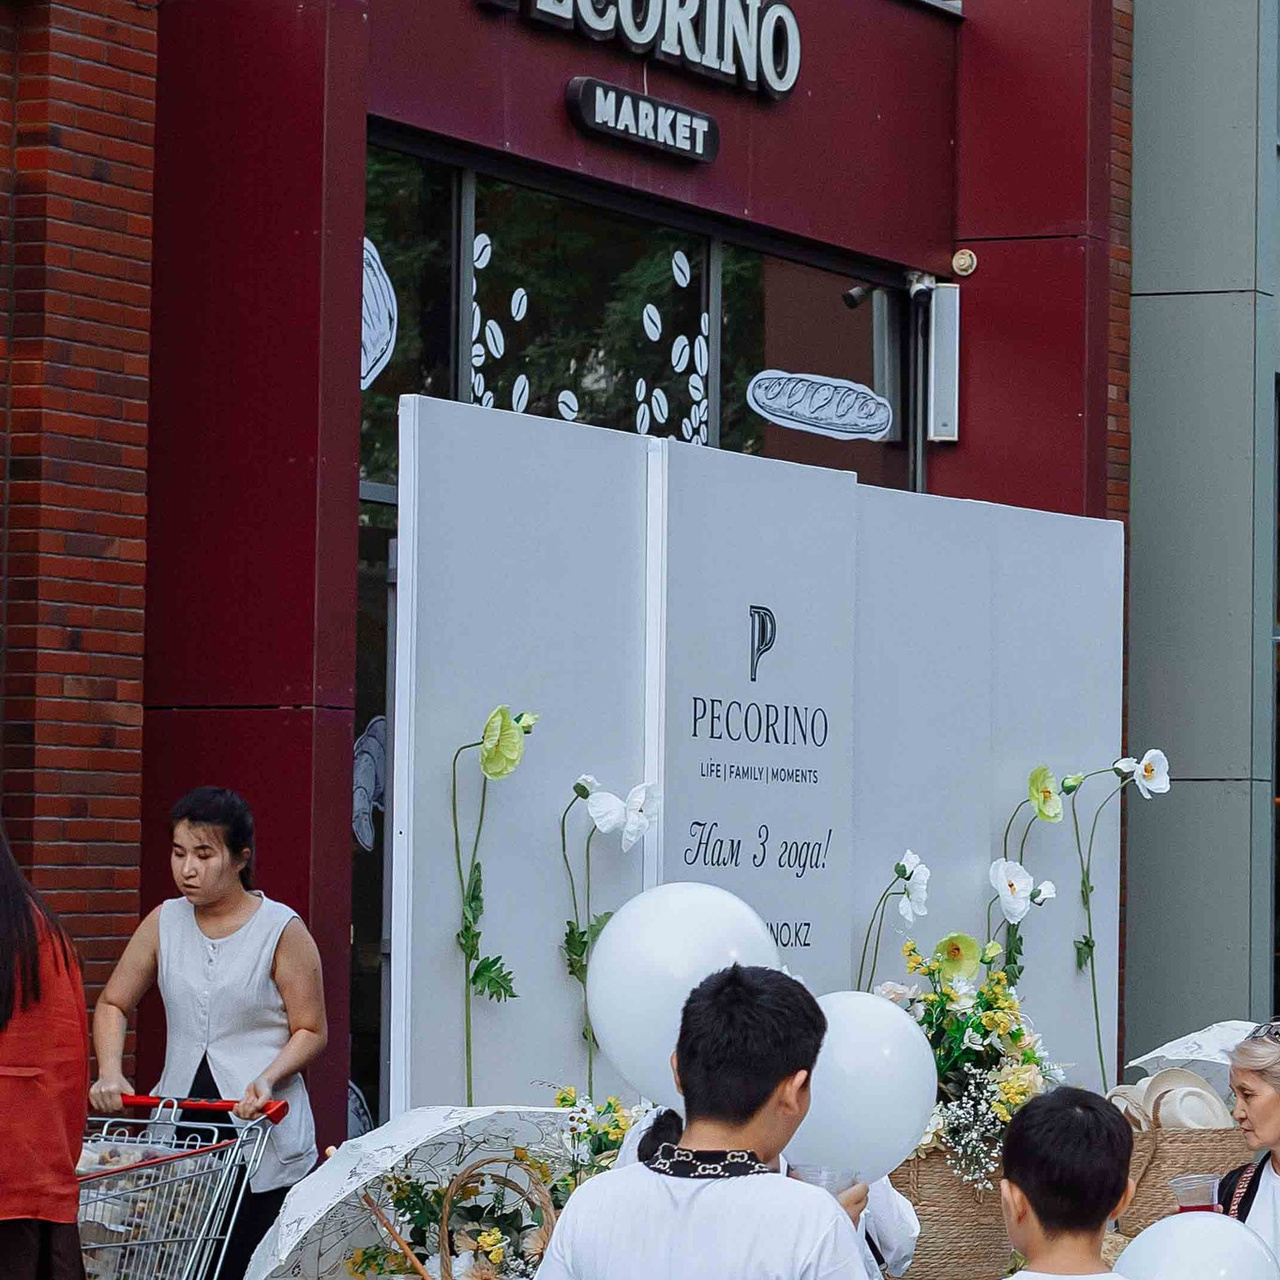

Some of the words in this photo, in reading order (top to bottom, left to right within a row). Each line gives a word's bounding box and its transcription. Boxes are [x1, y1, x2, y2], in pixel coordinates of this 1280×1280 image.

[594, 86, 709, 155] MARKET
[691, 696, 828, 747] PECORINO
[700, 762, 721, 779] LIFE
[729, 764, 764, 781] FAMILY
[771, 767, 819, 784] MOMENTS
[684, 821, 742, 867] Нам
[752, 824, 769, 868] 3
[778, 828, 832, 878] года!
[766, 922, 811, 947] NO.KZ
